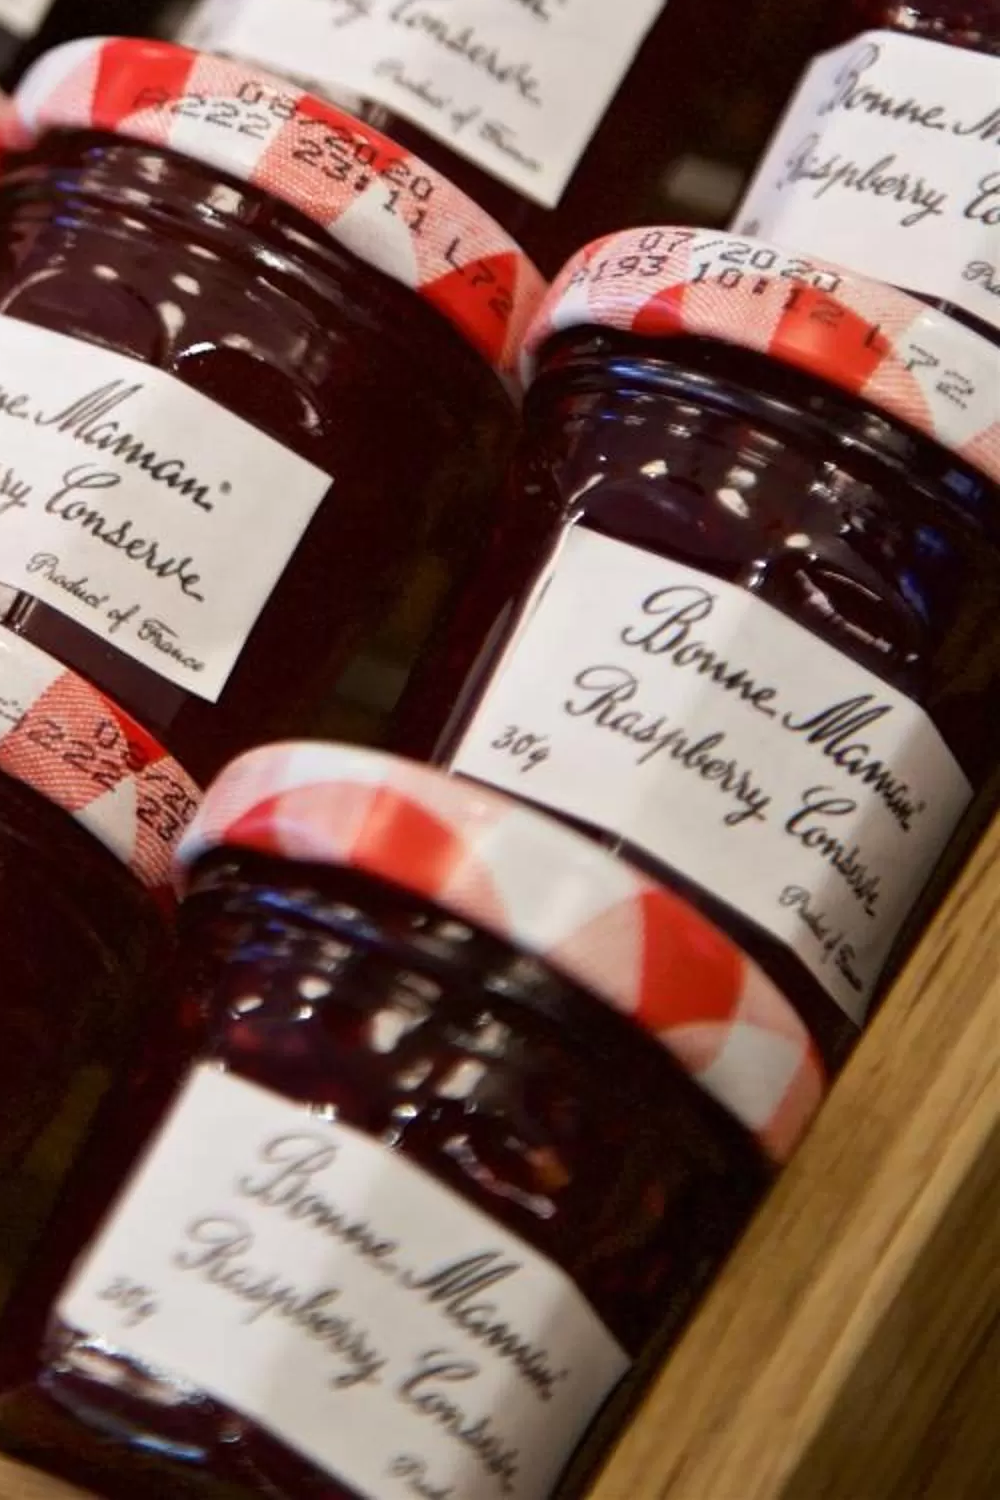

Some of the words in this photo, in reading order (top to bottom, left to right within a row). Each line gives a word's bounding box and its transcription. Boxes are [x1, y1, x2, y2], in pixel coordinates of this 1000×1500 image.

[637, 230, 844, 295] 07/2020
[33, 376, 214, 513] Maman
[44, 460, 206, 604] Conserve
[25, 550, 103, 610] Product
[105, 599, 136, 636] of
[138, 617, 206, 674] France
[619, 583, 779, 720] Bonne
[489, 723, 553, 774] 30g
[563, 662, 774, 829] Raspberry
